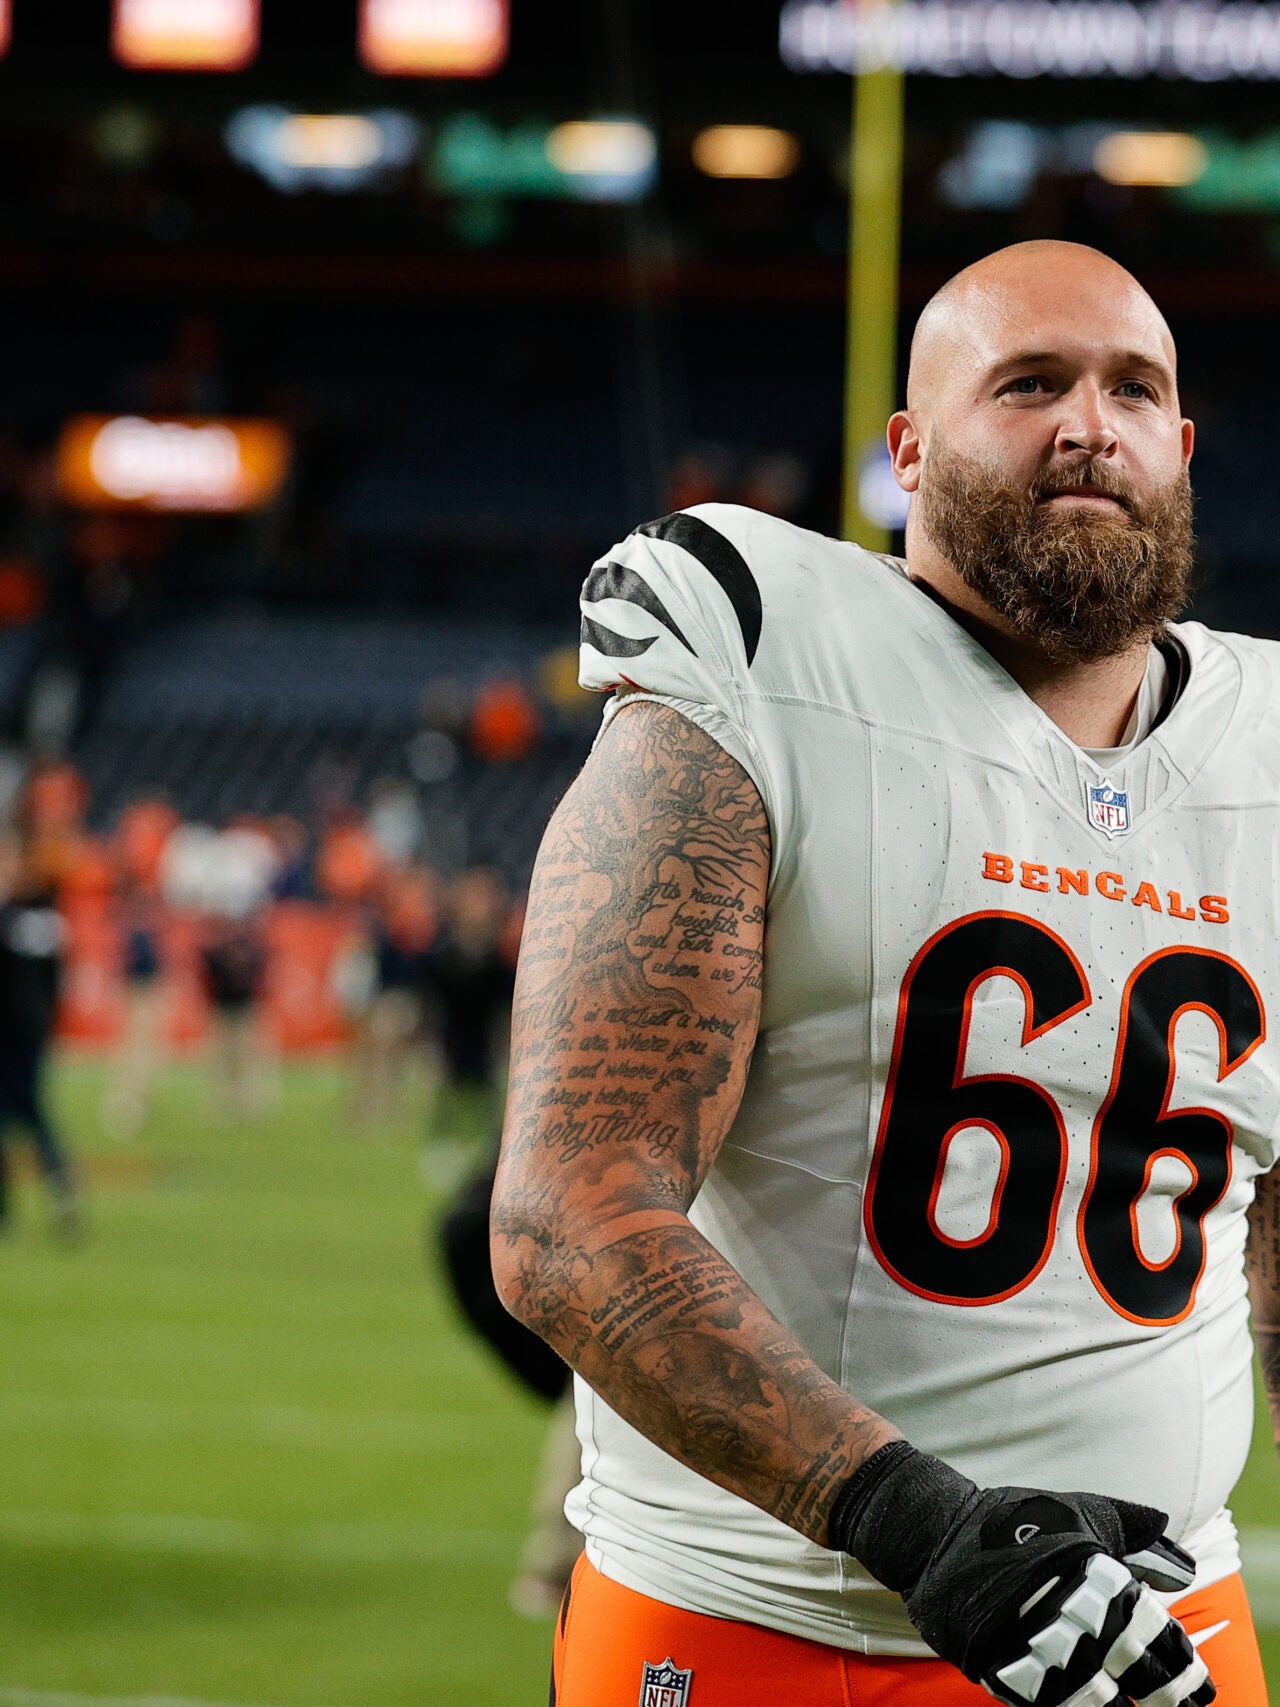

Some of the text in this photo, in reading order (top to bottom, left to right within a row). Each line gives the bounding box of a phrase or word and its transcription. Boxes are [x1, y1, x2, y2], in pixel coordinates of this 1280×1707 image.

[1094, 803, 1125, 828] NFL
[690, 888, 745, 912] reach
[982, 852, 1230, 924] BENGALS
[666, 1039, 708, 1062] you
[567, 1059, 605, 1080] and
[653, 1069, 697, 1093] you
[864, 909, 1266, 1327] 66
[622, 1280, 639, 1299] of
[638, 1268, 670, 1290] you
[646, 1686, 678, 1707] NFL
